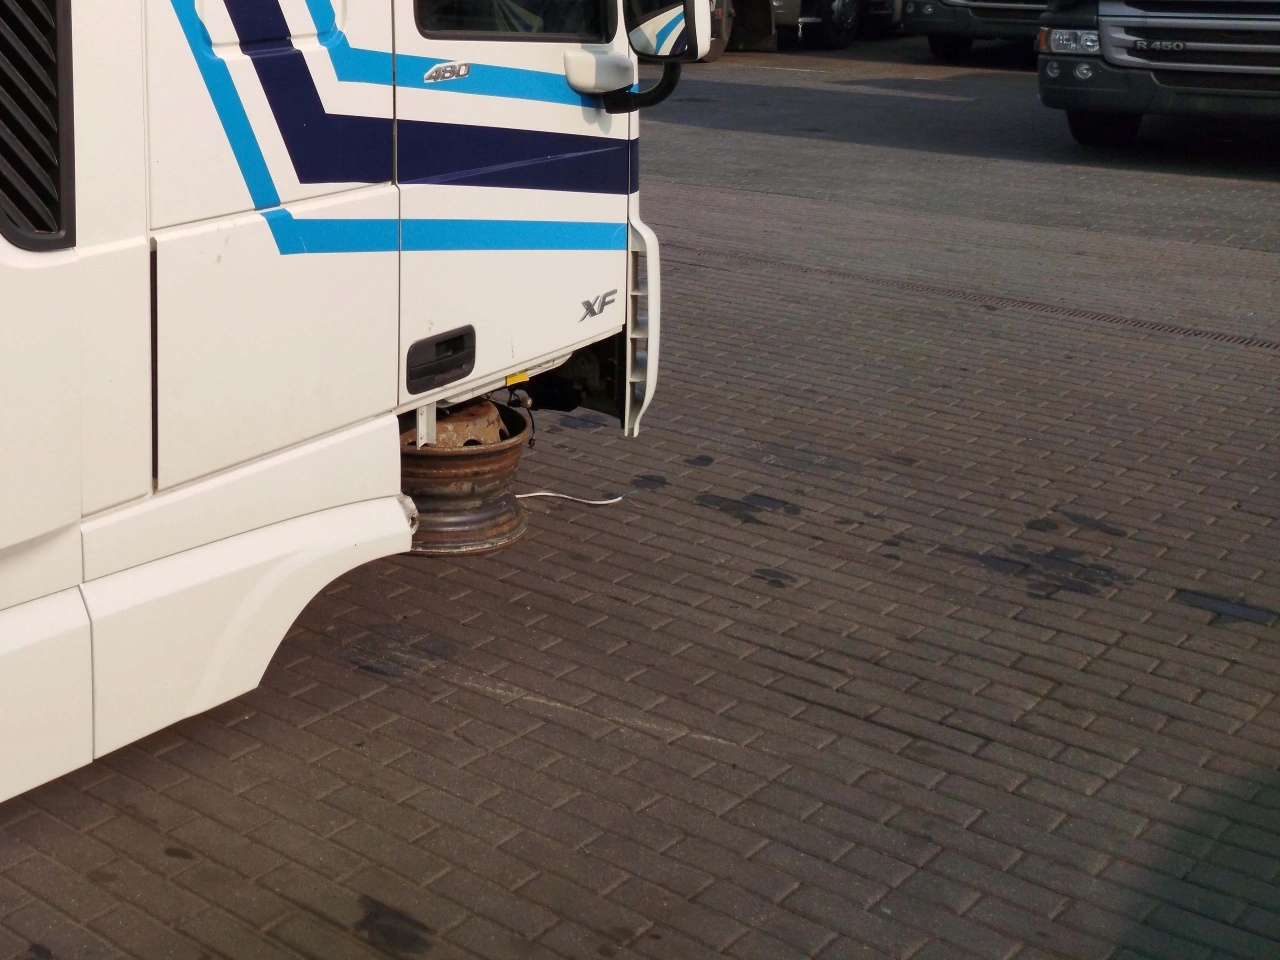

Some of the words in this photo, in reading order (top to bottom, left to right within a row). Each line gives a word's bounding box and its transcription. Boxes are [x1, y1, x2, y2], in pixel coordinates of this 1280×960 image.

[1136, 40, 1148, 50] R
[1150, 41, 1185, 51] 450
[424, 62, 471, 83] 480
[578, 288, 618, 323] XF
